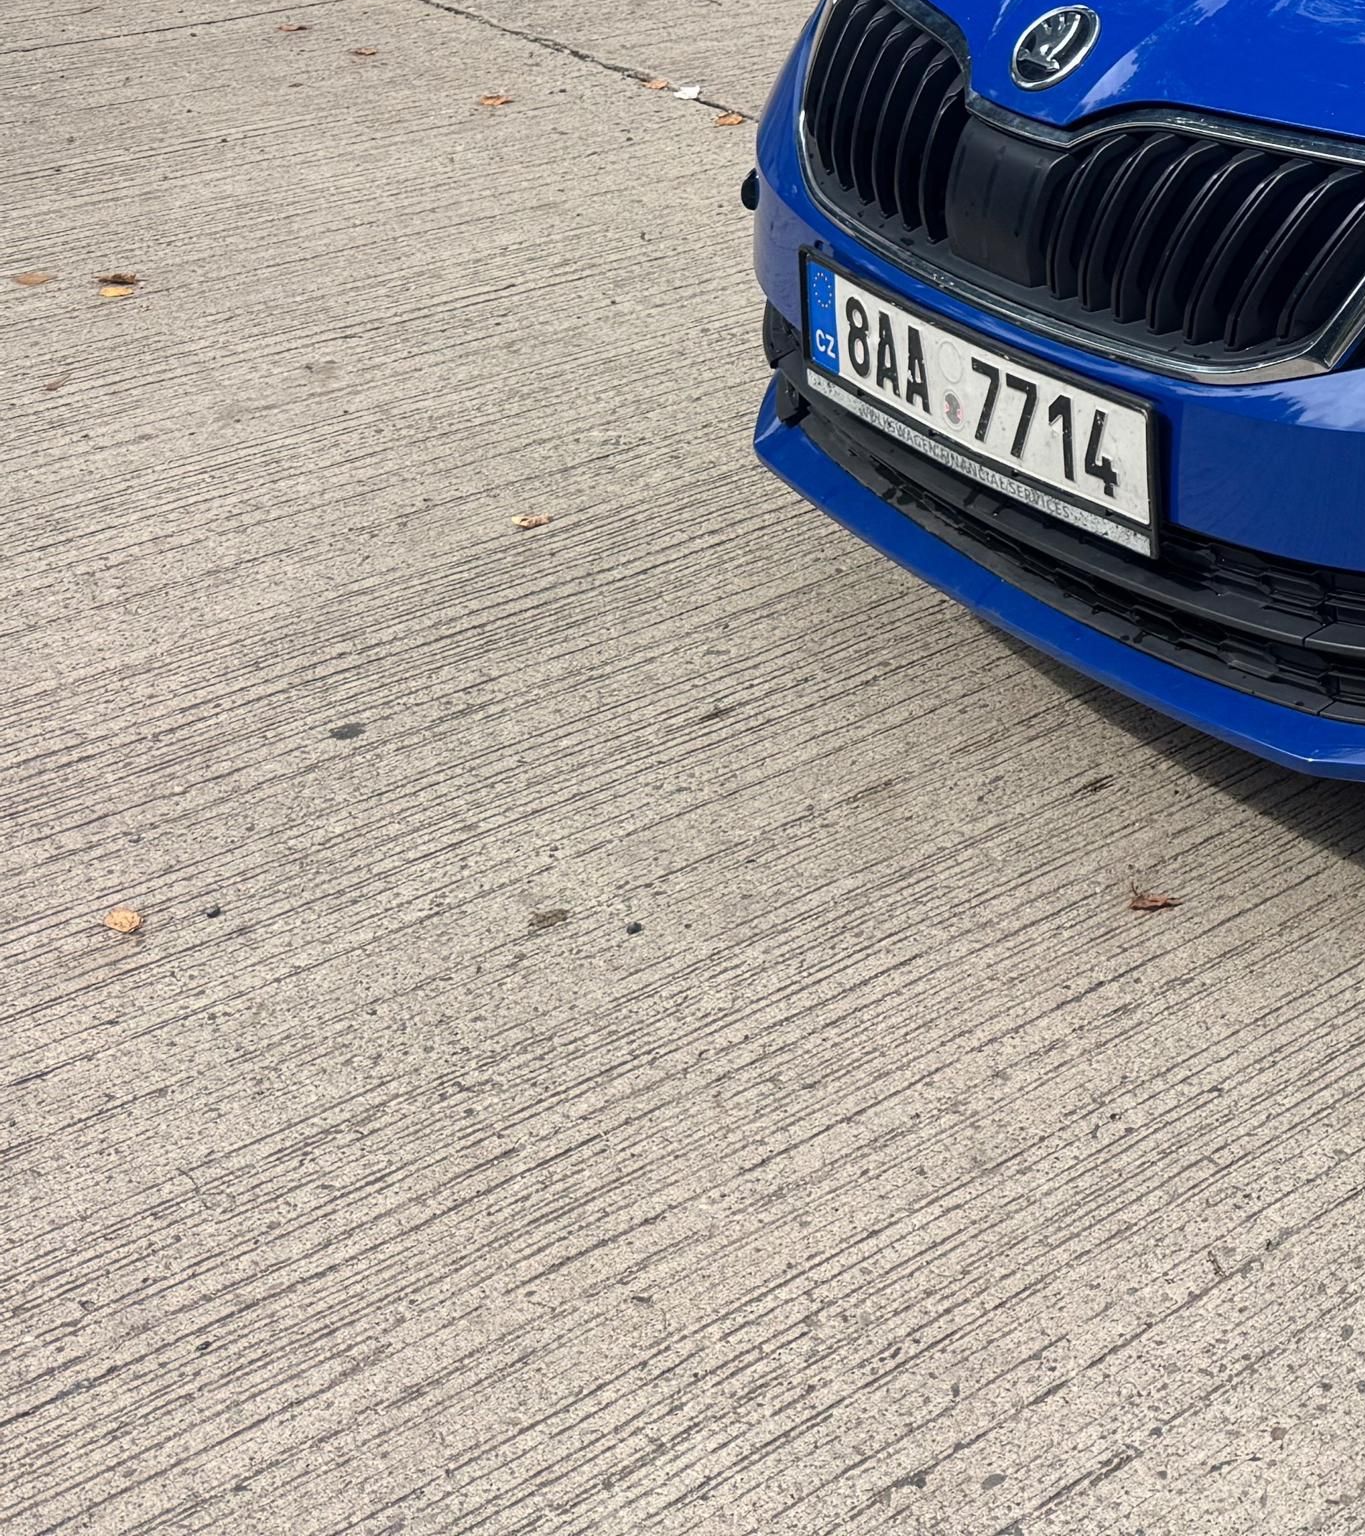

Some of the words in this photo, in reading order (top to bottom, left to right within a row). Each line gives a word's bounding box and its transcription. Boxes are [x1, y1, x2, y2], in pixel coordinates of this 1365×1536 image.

[815, 329, 837, 358] CZ
[845, 295, 931, 415] 8AA
[972, 356, 1120, 497] 7714
[1008, 480, 1070, 519] SERVICES
